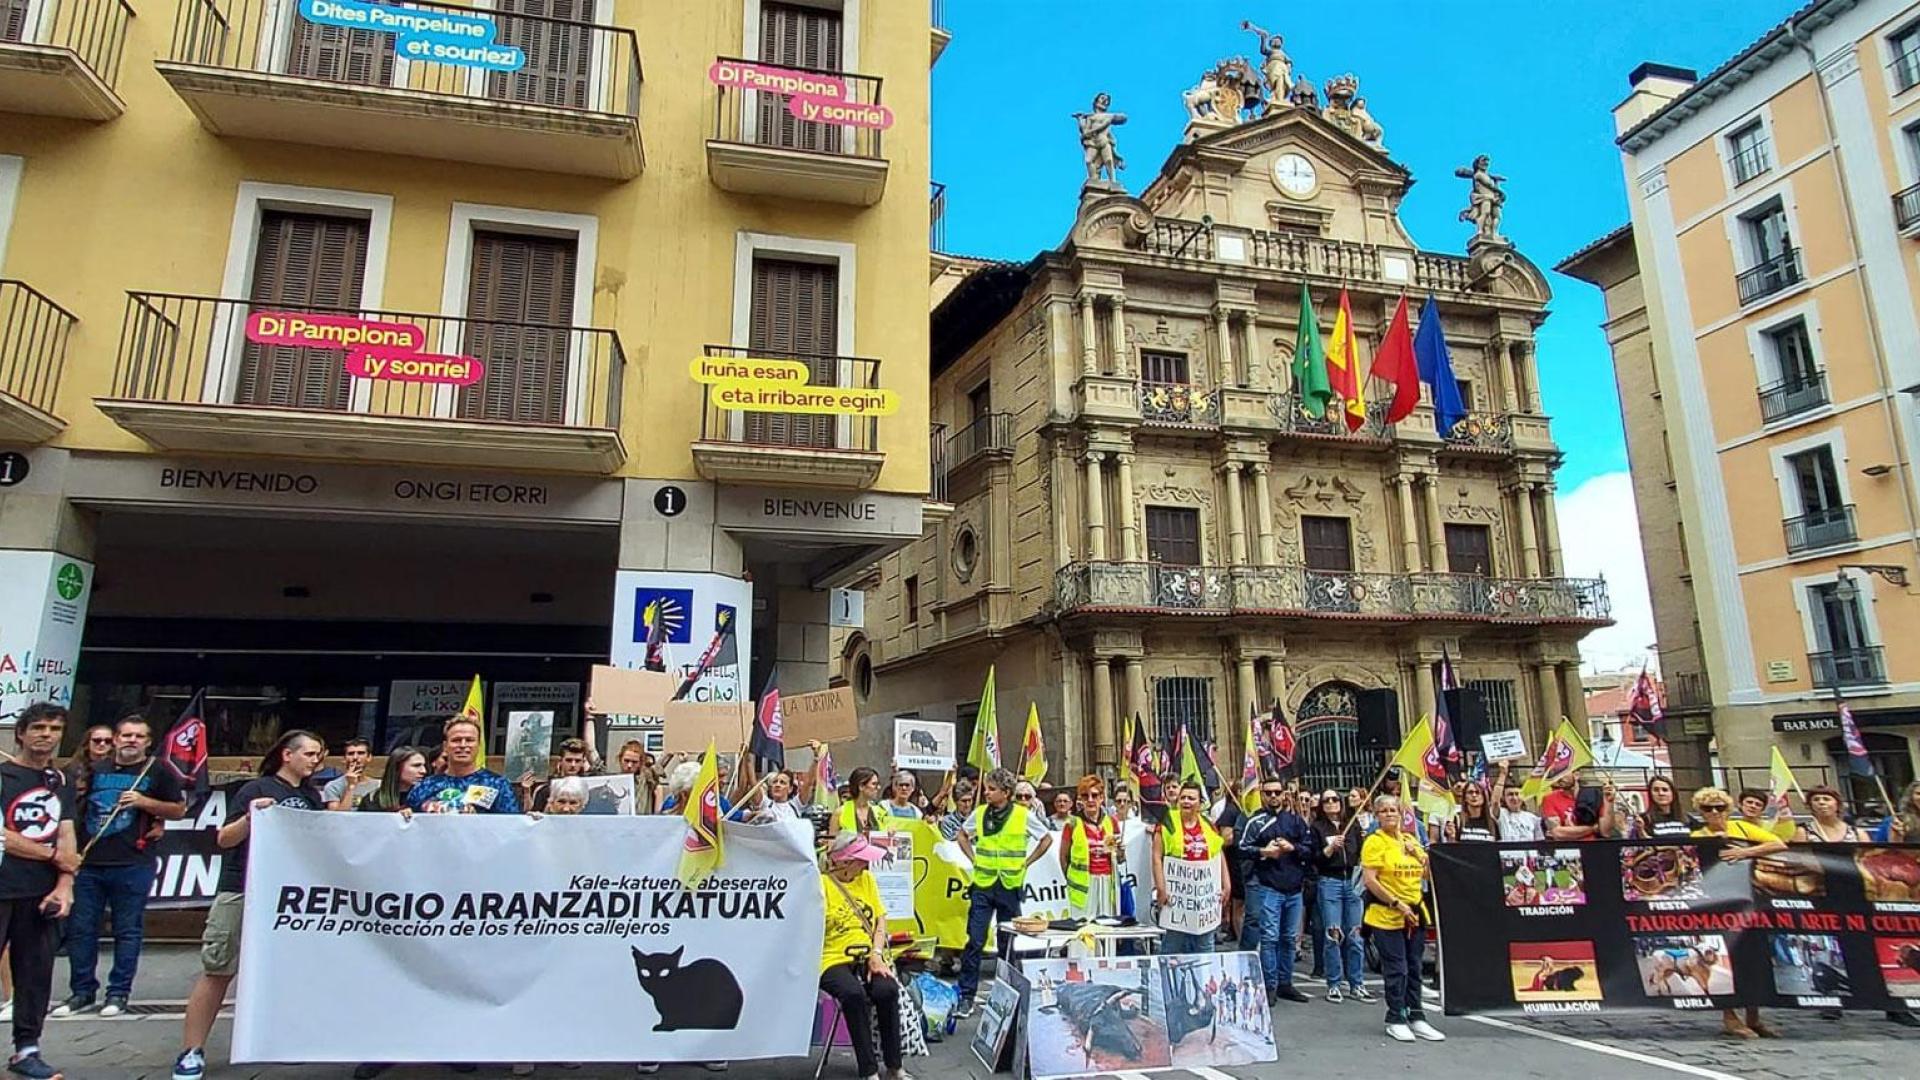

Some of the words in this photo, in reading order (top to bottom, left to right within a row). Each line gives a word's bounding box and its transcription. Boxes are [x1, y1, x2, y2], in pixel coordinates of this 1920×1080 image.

[311, 1, 367, 21] Dites
[369, 9, 485, 37] Pampelune
[406, 40, 432, 55] et
[717, 66, 739, 82] Di
[743, 69, 839, 97] Pamplona
[258, 317, 285, 336] Di
[289, 320, 413, 347] Pamplona
[390, 357, 471, 379] sonríe!
[701, 361, 749, 378] Iruña
[753, 368, 799, 380] esan
[721, 388, 754, 404] eta
[758, 388, 835, 407] irribarre
[839, 392, 886, 413] egin!
[160, 468, 318, 494] BIENVENIDO
[394, 480, 461, 500] ONGI
[469, 484, 548, 504] ETORRI
[764, 499, 876, 520] BIENVENUE
[1783, 719, 1808, 731] BAR
[569, 875, 682, 890] Kale-katuen
[685, 875, 787, 890] abeserako
[277, 886, 445, 920] REFUGIO
[452, 892, 640, 920] ARANZADI
[650, 892, 785, 920] KATUAK
[1648, 901, 1690, 911] FIESTA
[274, 915, 315, 931] Por
[317, 915, 335, 931] la
[338, 919, 445, 936] protección
[450, 920, 475, 936] de
[479, 921, 508, 936] los
[514, 918, 579, 937] felinos
[584, 919, 670, 938] callejeros
[1170, 911, 1188, 927] LA
[1626, 911, 1773, 932] TAUROMAQUIA
[1776, 913, 1795, 928] NI
[1801, 914, 1841, 930] ARTE
[1846, 915, 1866, 931] NI
[1523, 1001, 1600, 1012] HUMILLACIÓN
[1673, 997, 1714, 1008] BURLA
